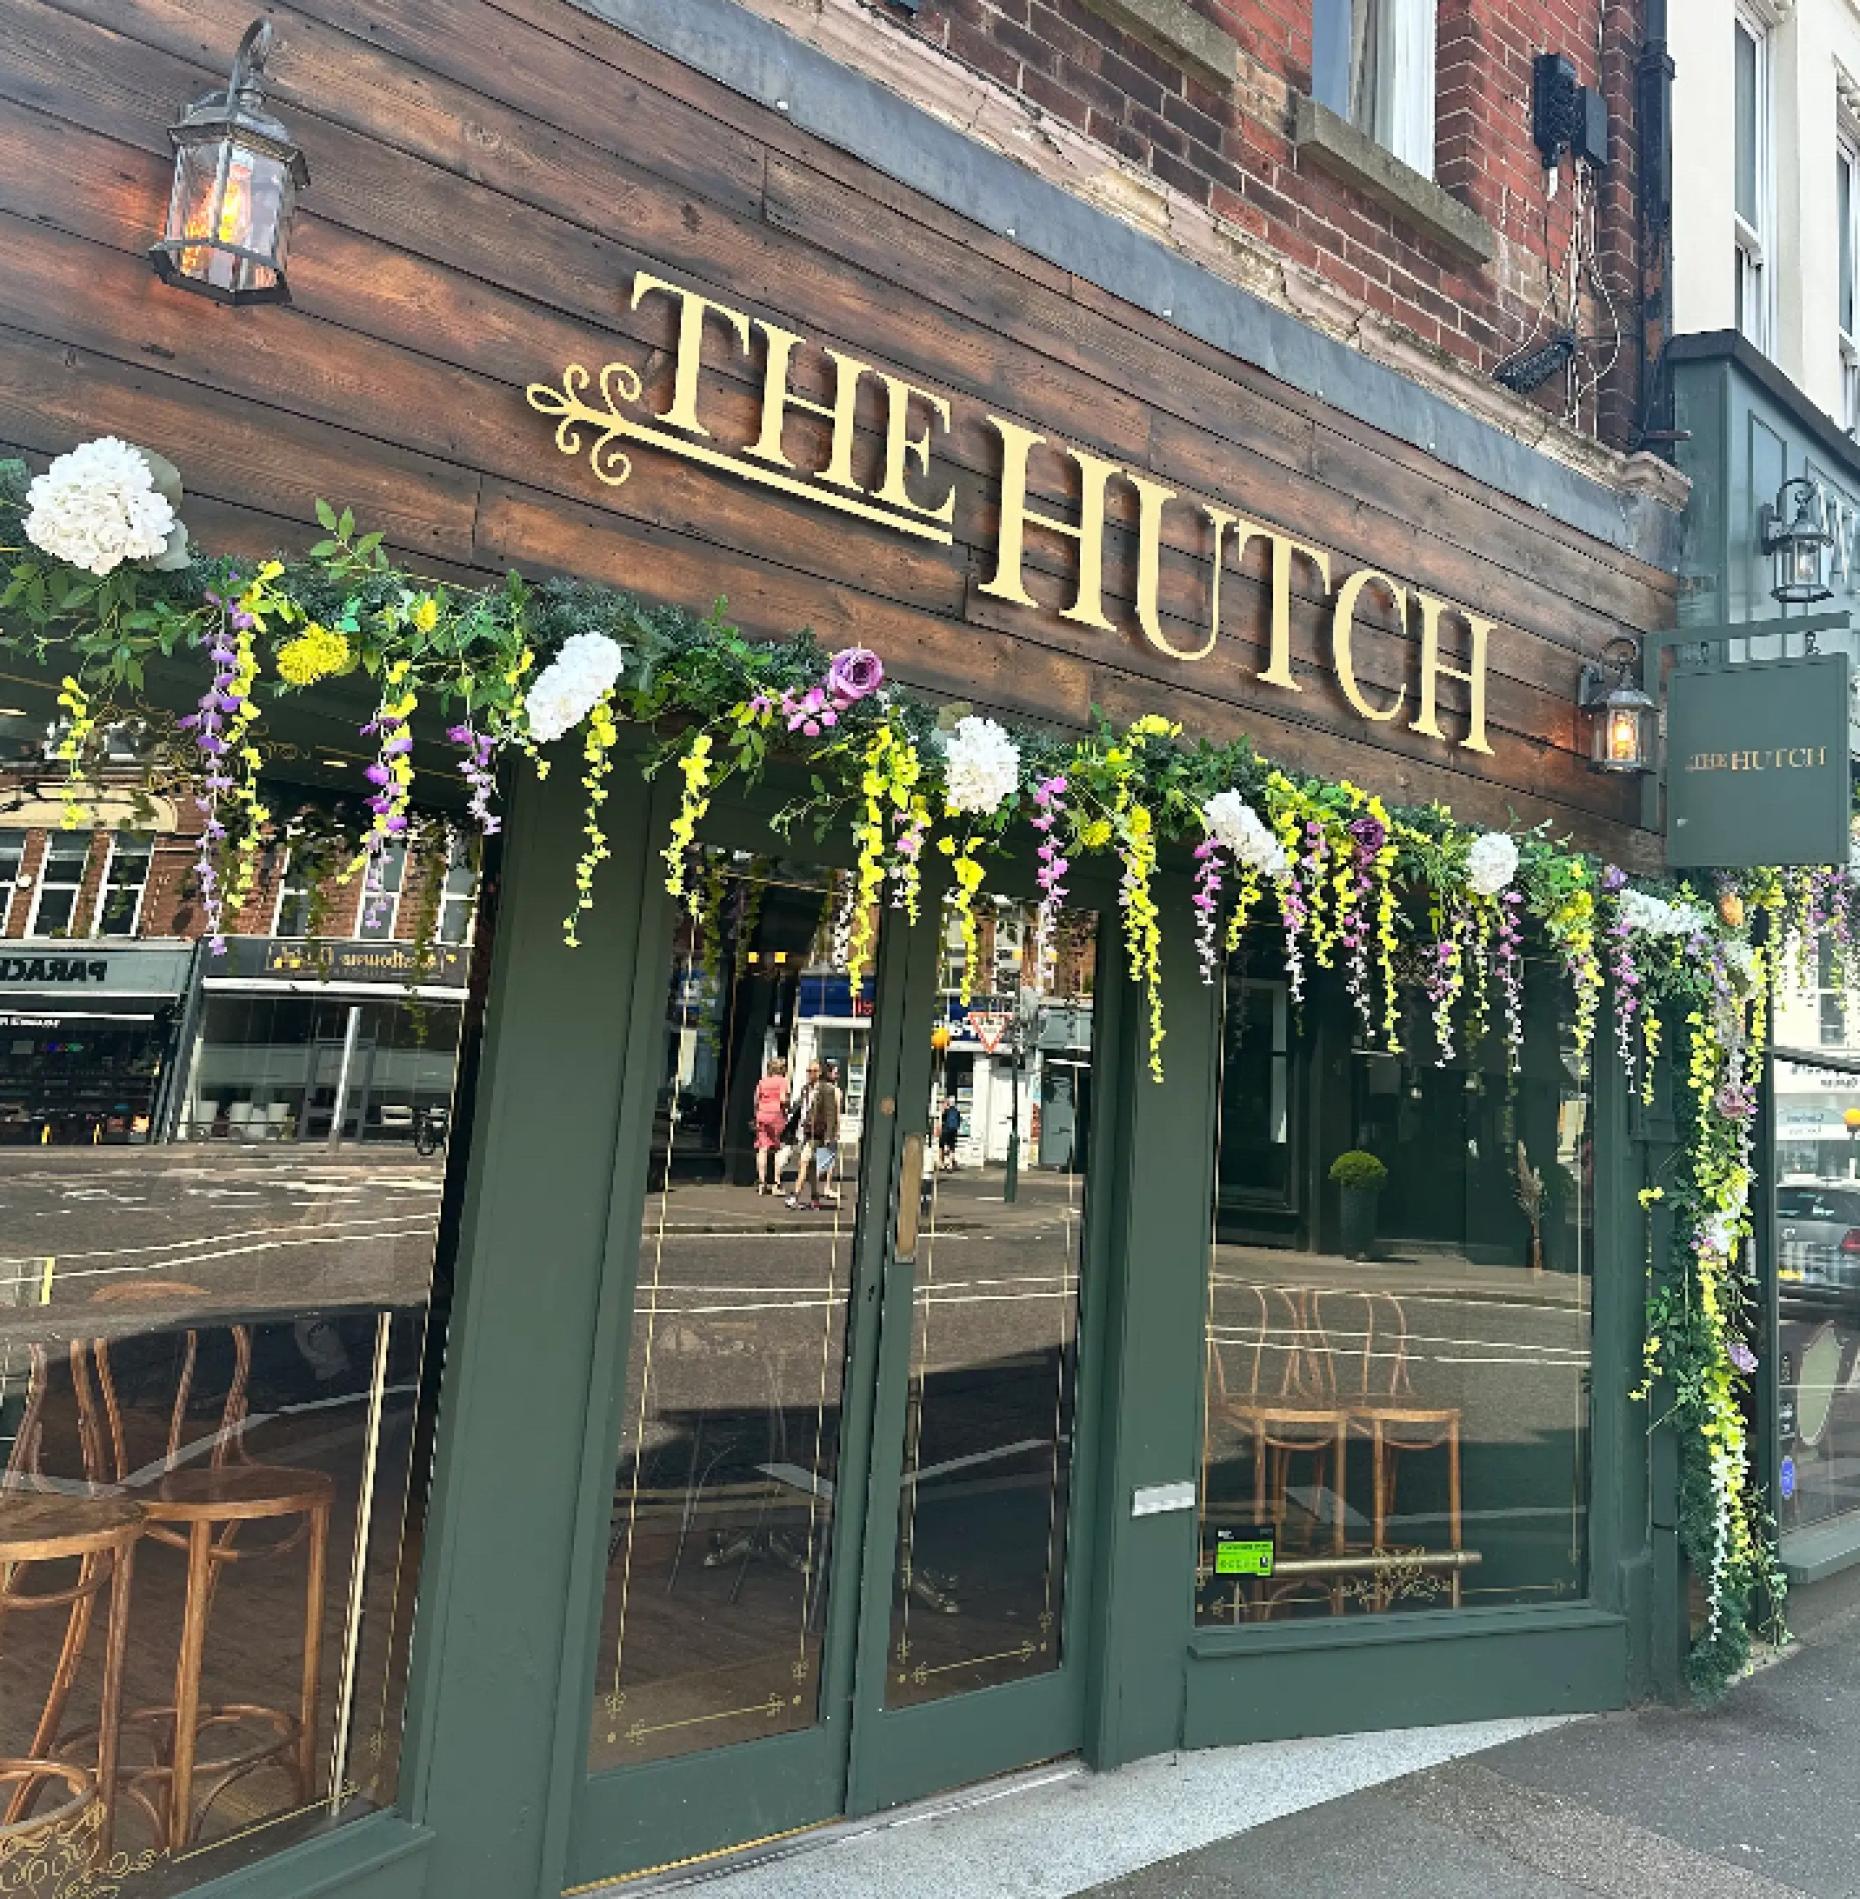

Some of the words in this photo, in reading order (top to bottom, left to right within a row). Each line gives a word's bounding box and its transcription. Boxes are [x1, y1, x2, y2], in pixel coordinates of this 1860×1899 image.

[631, 270, 957, 525] THE
[977, 414, 1498, 756] HUTCH
[1689, 753, 1728, 769] THE
[1731, 746, 1827, 771] HUTCH
